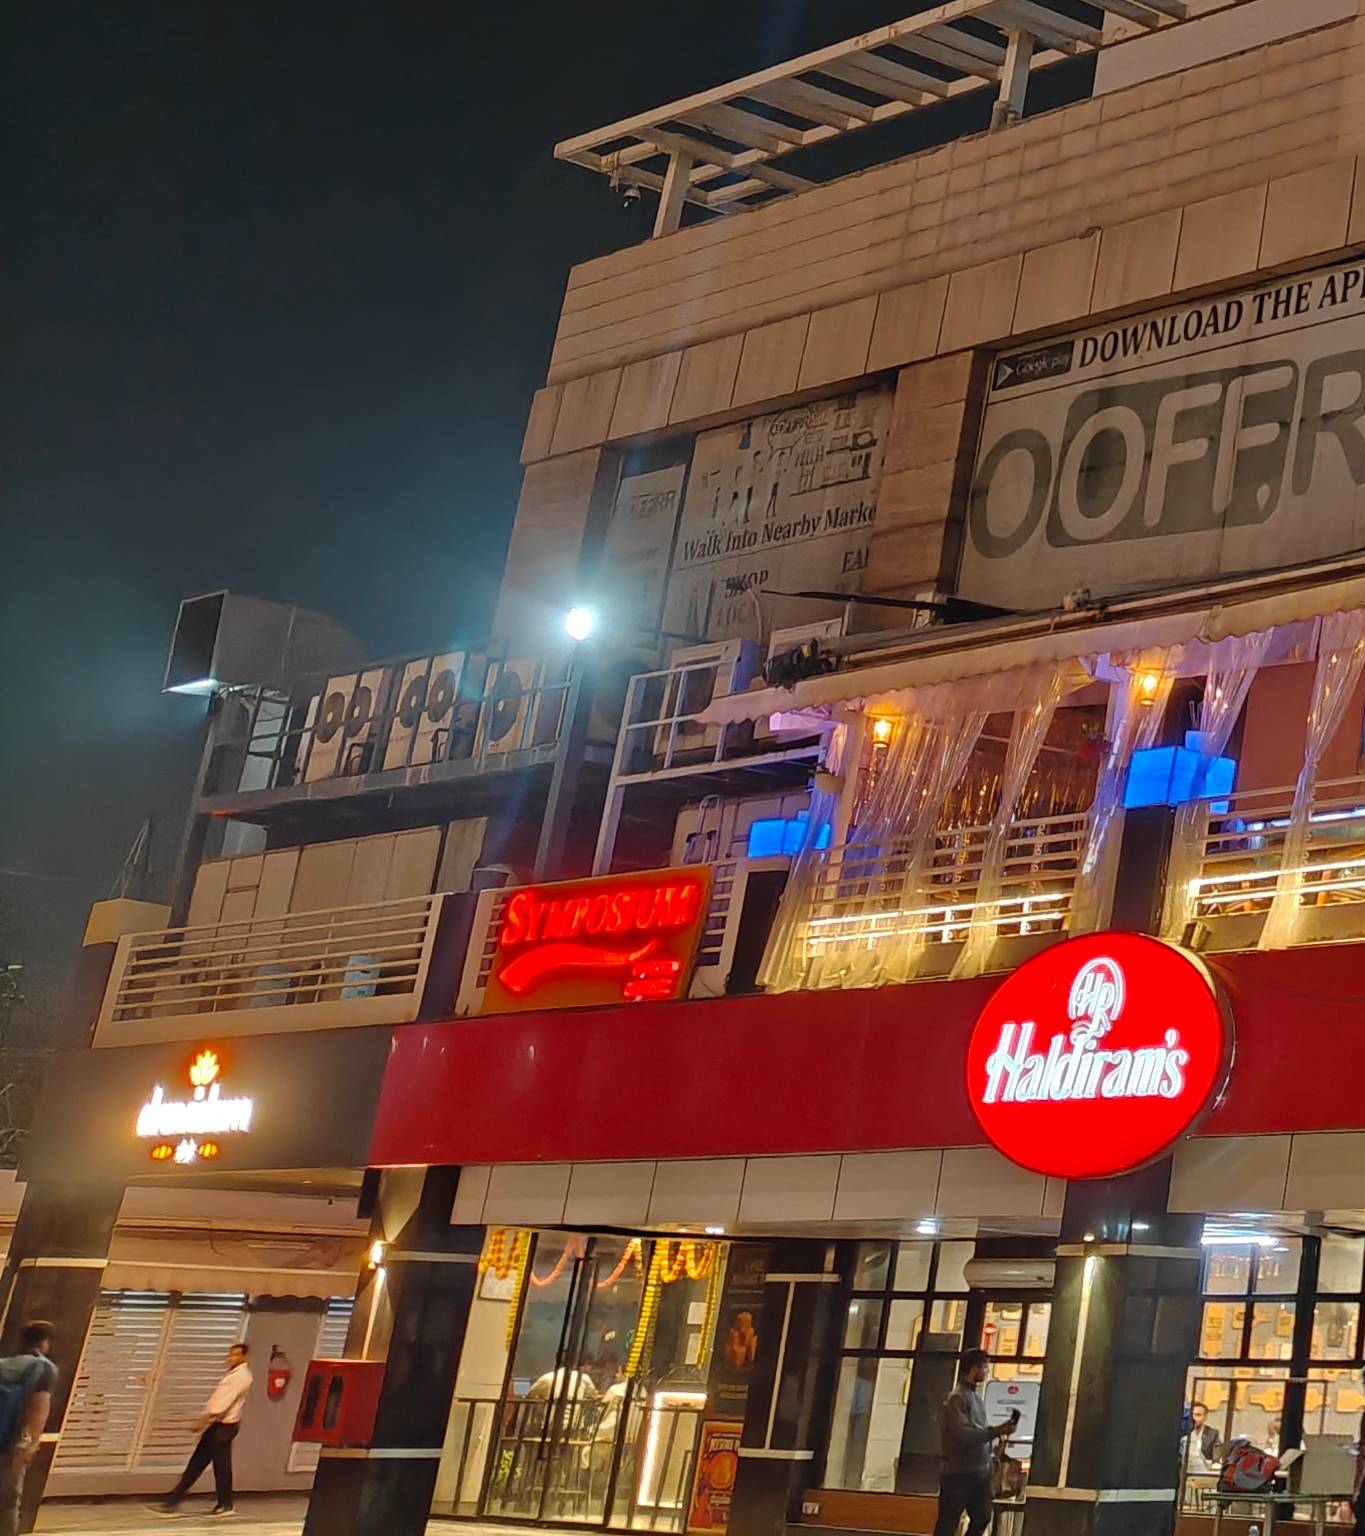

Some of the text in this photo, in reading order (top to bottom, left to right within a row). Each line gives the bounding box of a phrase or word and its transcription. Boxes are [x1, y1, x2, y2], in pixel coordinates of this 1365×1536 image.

[1077, 294, 1245, 369] DOWNLOAD
[1250, 281, 1311, 325] THE
[683, 530, 721, 562] Walk
[724, 528, 758, 554] Into
[760, 513, 822, 545] Nearby
[501, 884, 697, 946] SYMPOSIUM
[982, 1020, 1191, 1105] Haldiram's
